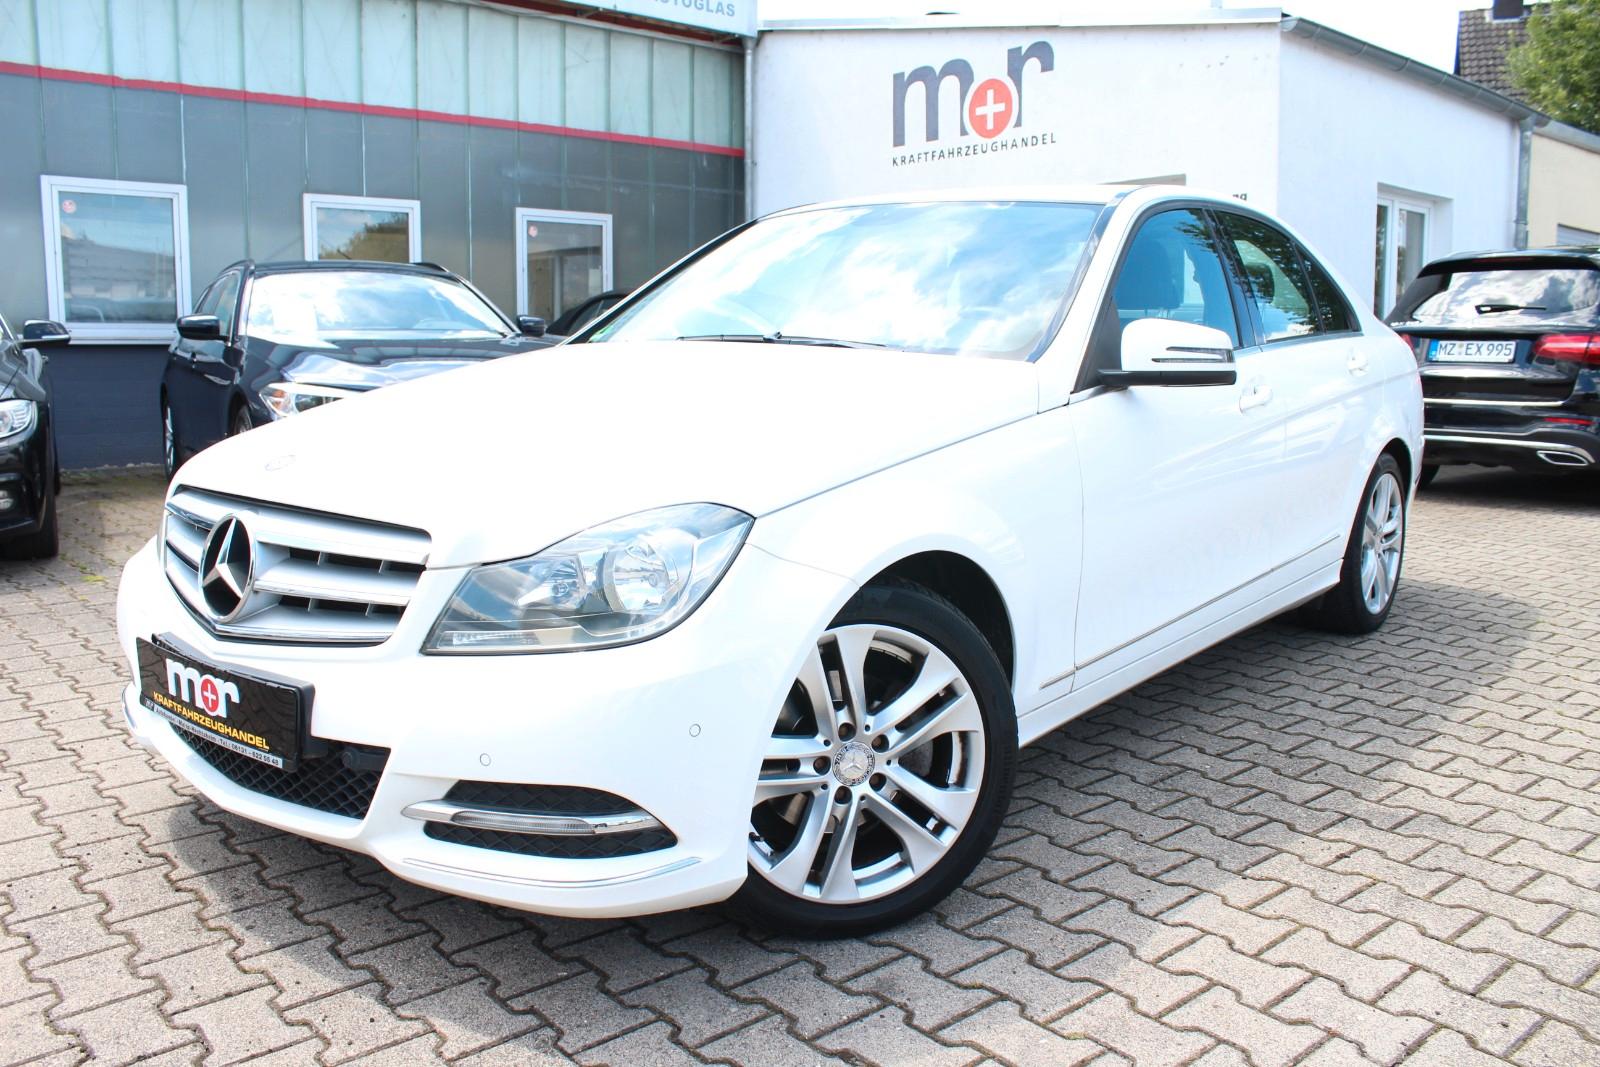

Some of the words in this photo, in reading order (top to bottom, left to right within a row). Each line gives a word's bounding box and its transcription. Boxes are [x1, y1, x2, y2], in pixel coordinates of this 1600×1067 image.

[655, 0, 735, 17] OGLAS
[892, 132, 1057, 167] KRAFTFAHRZEUGHANDEL
[1438, 342, 1457, 356] MZ
[1464, 342, 1484, 356] EX
[1486, 342, 1513, 357] 995
[153, 690, 270, 750] KRAFTFAHRZEUGHANDEL
